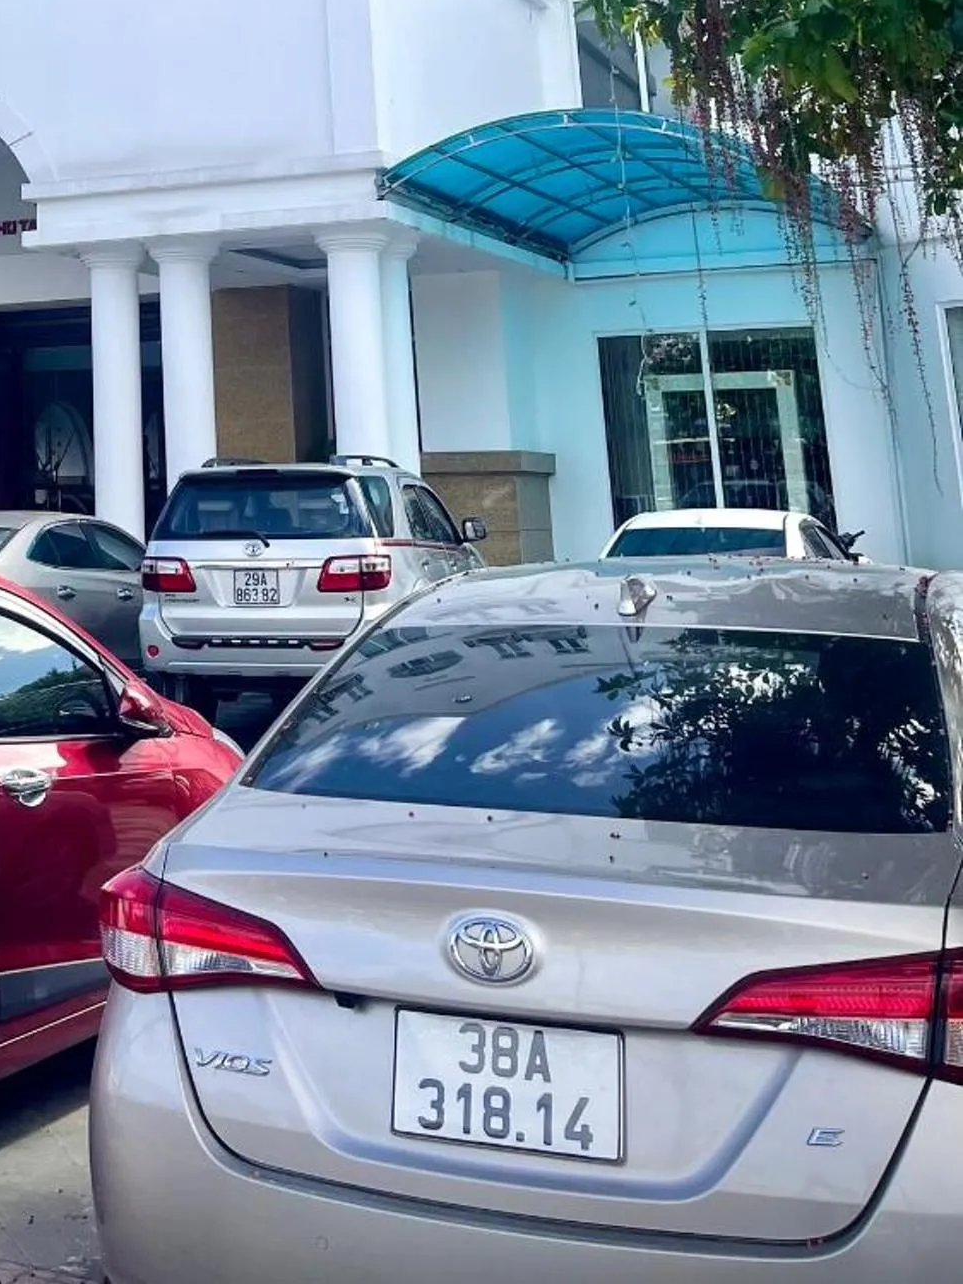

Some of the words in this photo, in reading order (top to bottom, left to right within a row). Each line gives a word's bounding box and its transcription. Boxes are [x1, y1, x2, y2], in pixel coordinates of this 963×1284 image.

[244, 572, 268, 586] 29A
[194, 1047, 274, 1077] VIOS
[458, 1021, 552, 1084] 38A
[417, 1077, 594, 1151] 318.14
[806, 1126, 846, 1148] E
